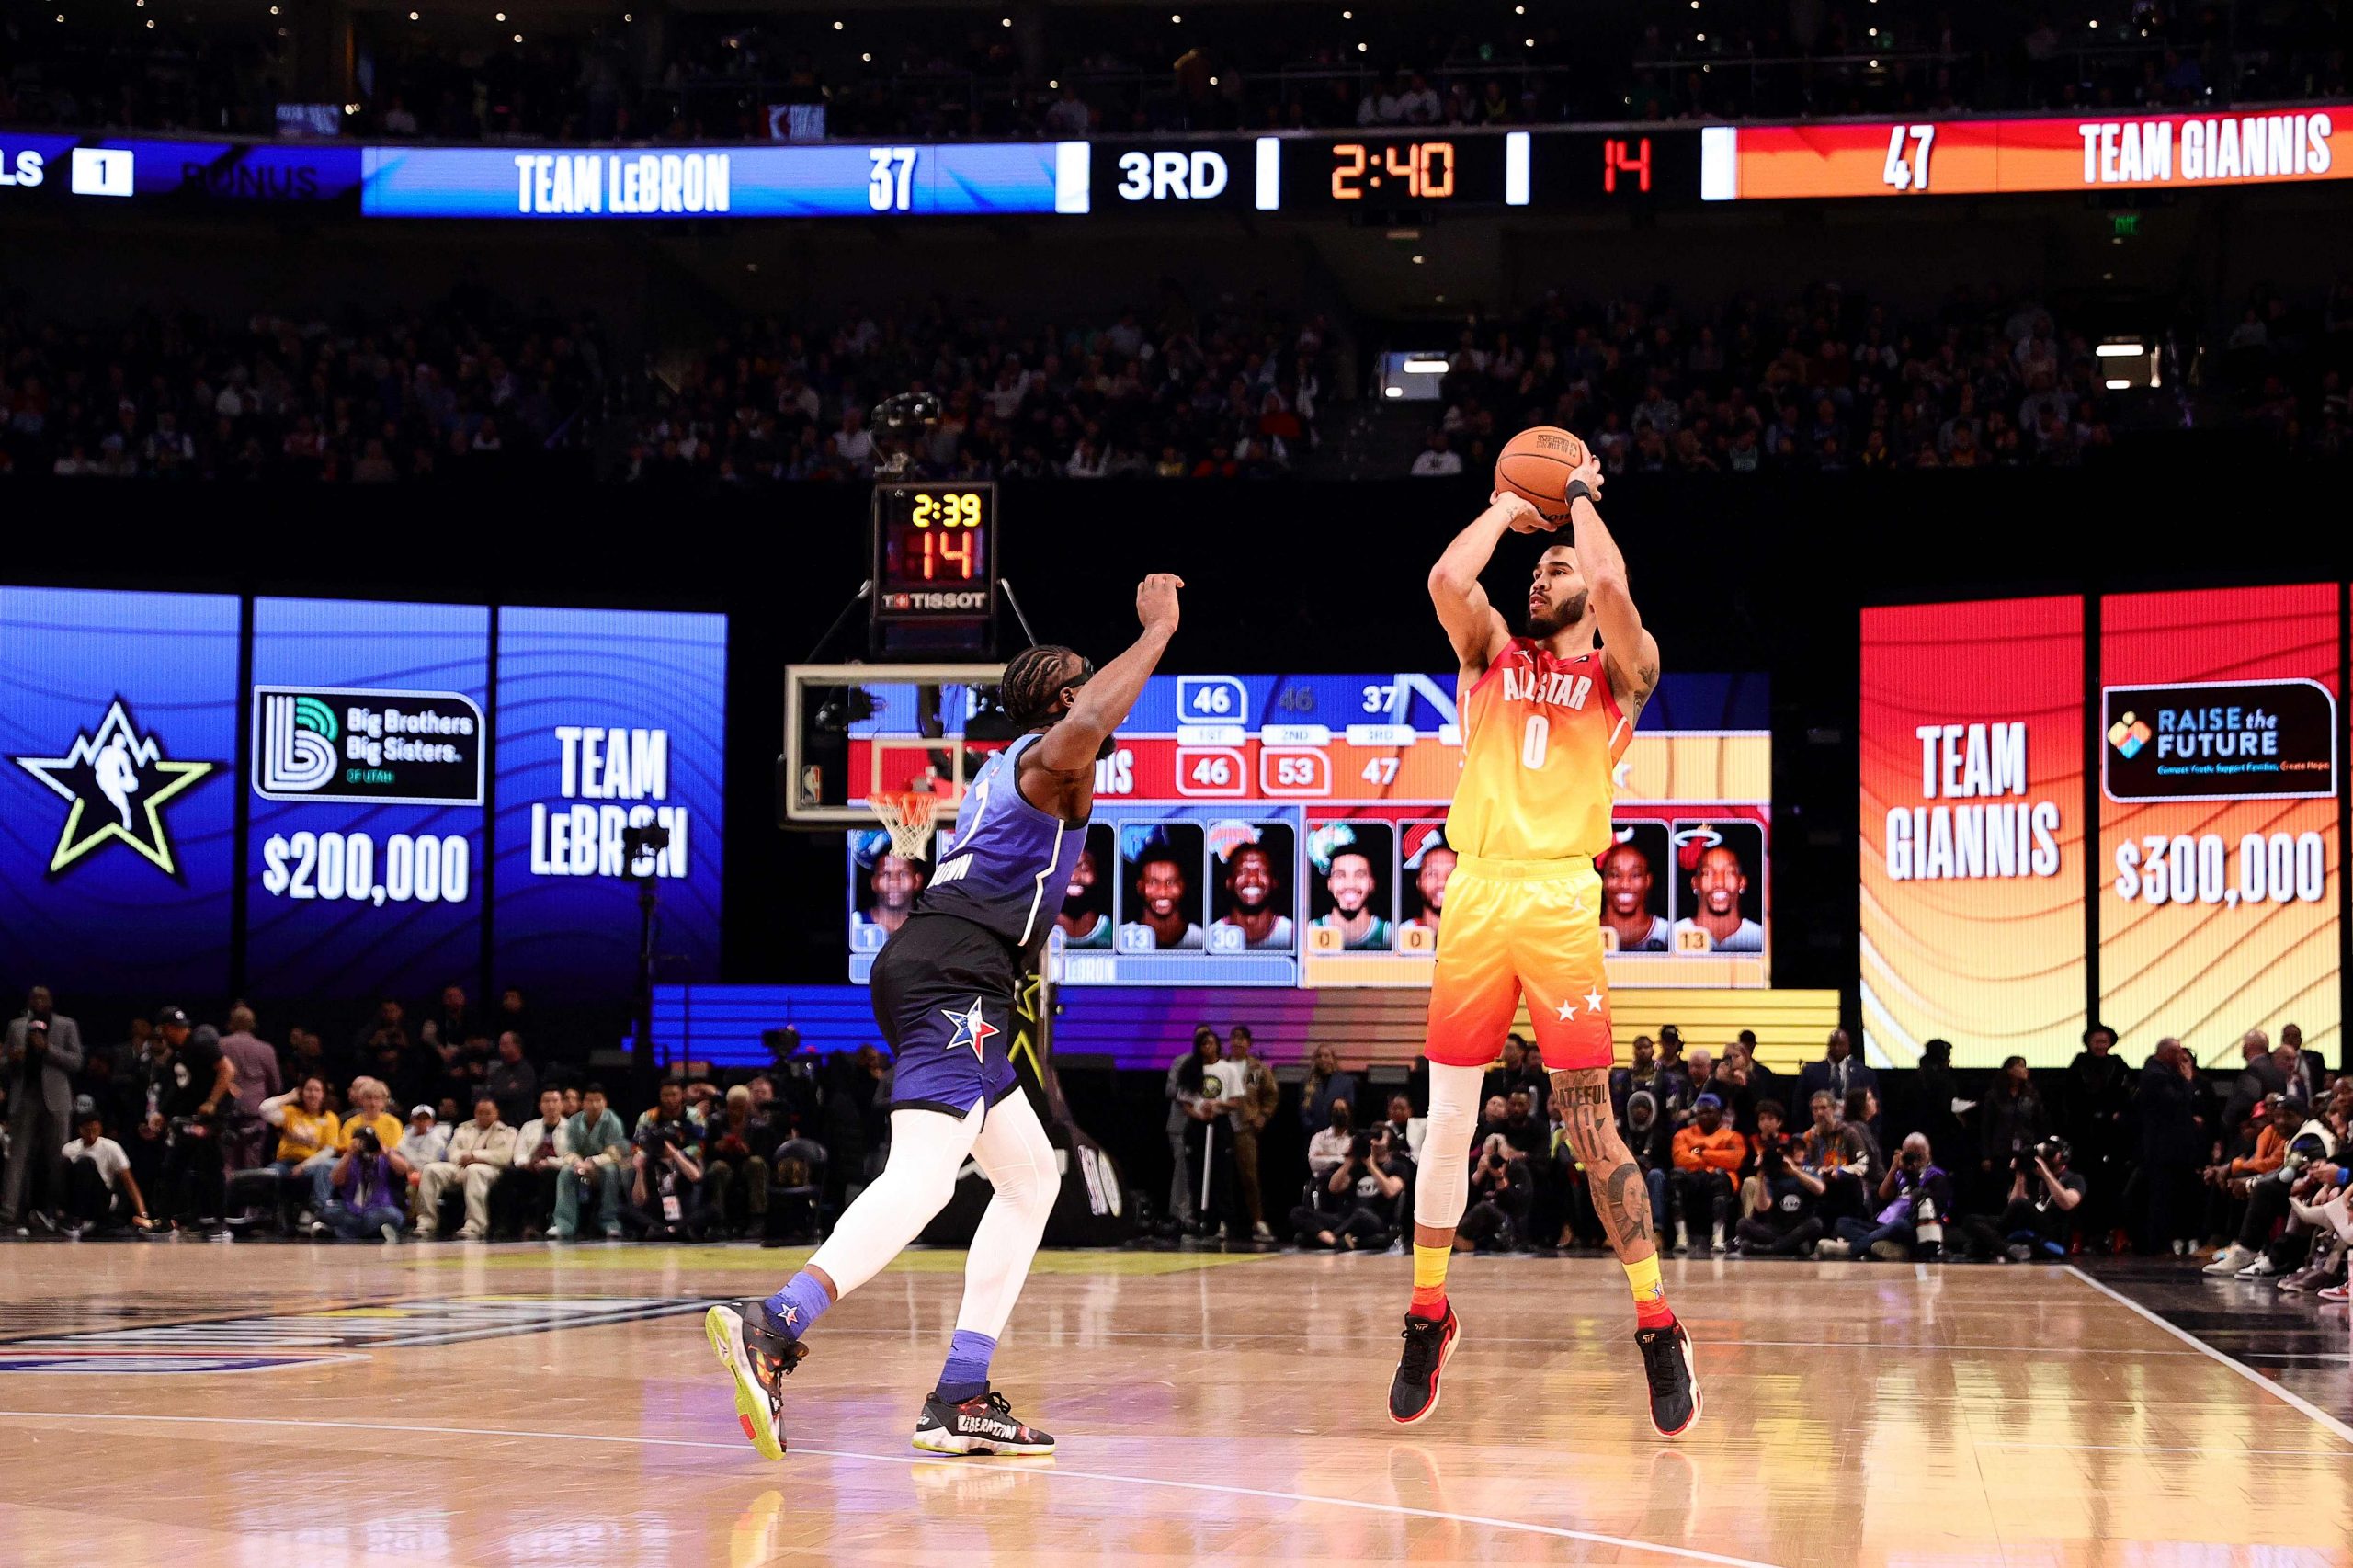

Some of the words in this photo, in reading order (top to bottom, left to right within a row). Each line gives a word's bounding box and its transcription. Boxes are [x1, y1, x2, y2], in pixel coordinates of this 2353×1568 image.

[1605, 139, 1651, 193] 14
[1882, 124, 1935, 190] 47
[2078, 120, 2172, 183] TEAM
[2180, 112, 2332, 180] GIANNIS
[96, 159, 108, 187] 1
[514, 154, 602, 213] TEAM
[868, 146, 917, 211] 37
[1118, 150, 1229, 200] 3RD
[1331, 142, 1455, 199] 2:40
[912, 494, 982, 528] 2:39
[923, 531, 972, 580] 14
[909, 592, 987, 609] TISSOT
[1193, 686, 1232, 713] 46
[1279, 686, 1315, 713] 46
[1362, 686, 1398, 713] 37
[1502, 666, 1536, 702] ALL
[1536, 672, 1593, 711] STAR
[347, 707, 383, 739] Big
[384, 708, 474, 736] Brothers
[1282, 729, 1310, 741] 2ND
[2158, 706, 2243, 733] RAISE
[2245, 708, 2279, 731] the
[347, 735, 382, 767] Big
[1522, 714, 1551, 770] 0
[1916, 721, 2027, 799] TEAM
[2157, 730, 2279, 759] FUTURE
[346, 768, 362, 784] OF
[363, 768, 396, 784] UTAH
[555, 725, 668, 801] TEAM
[1192, 757, 1231, 785] 46
[1278, 757, 1314, 785] 53
[1361, 757, 1400, 785] 47
[1885, 801, 2061, 881] GIANNIS
[263, 831, 471, 908] $200,000
[2115, 830, 2325, 909] $300,000
[1123, 929, 1149, 949] 13
[1319, 931, 1330, 949] 0
[1411, 931, 1421, 949] 0
[1680, 932, 1704, 949] 13
